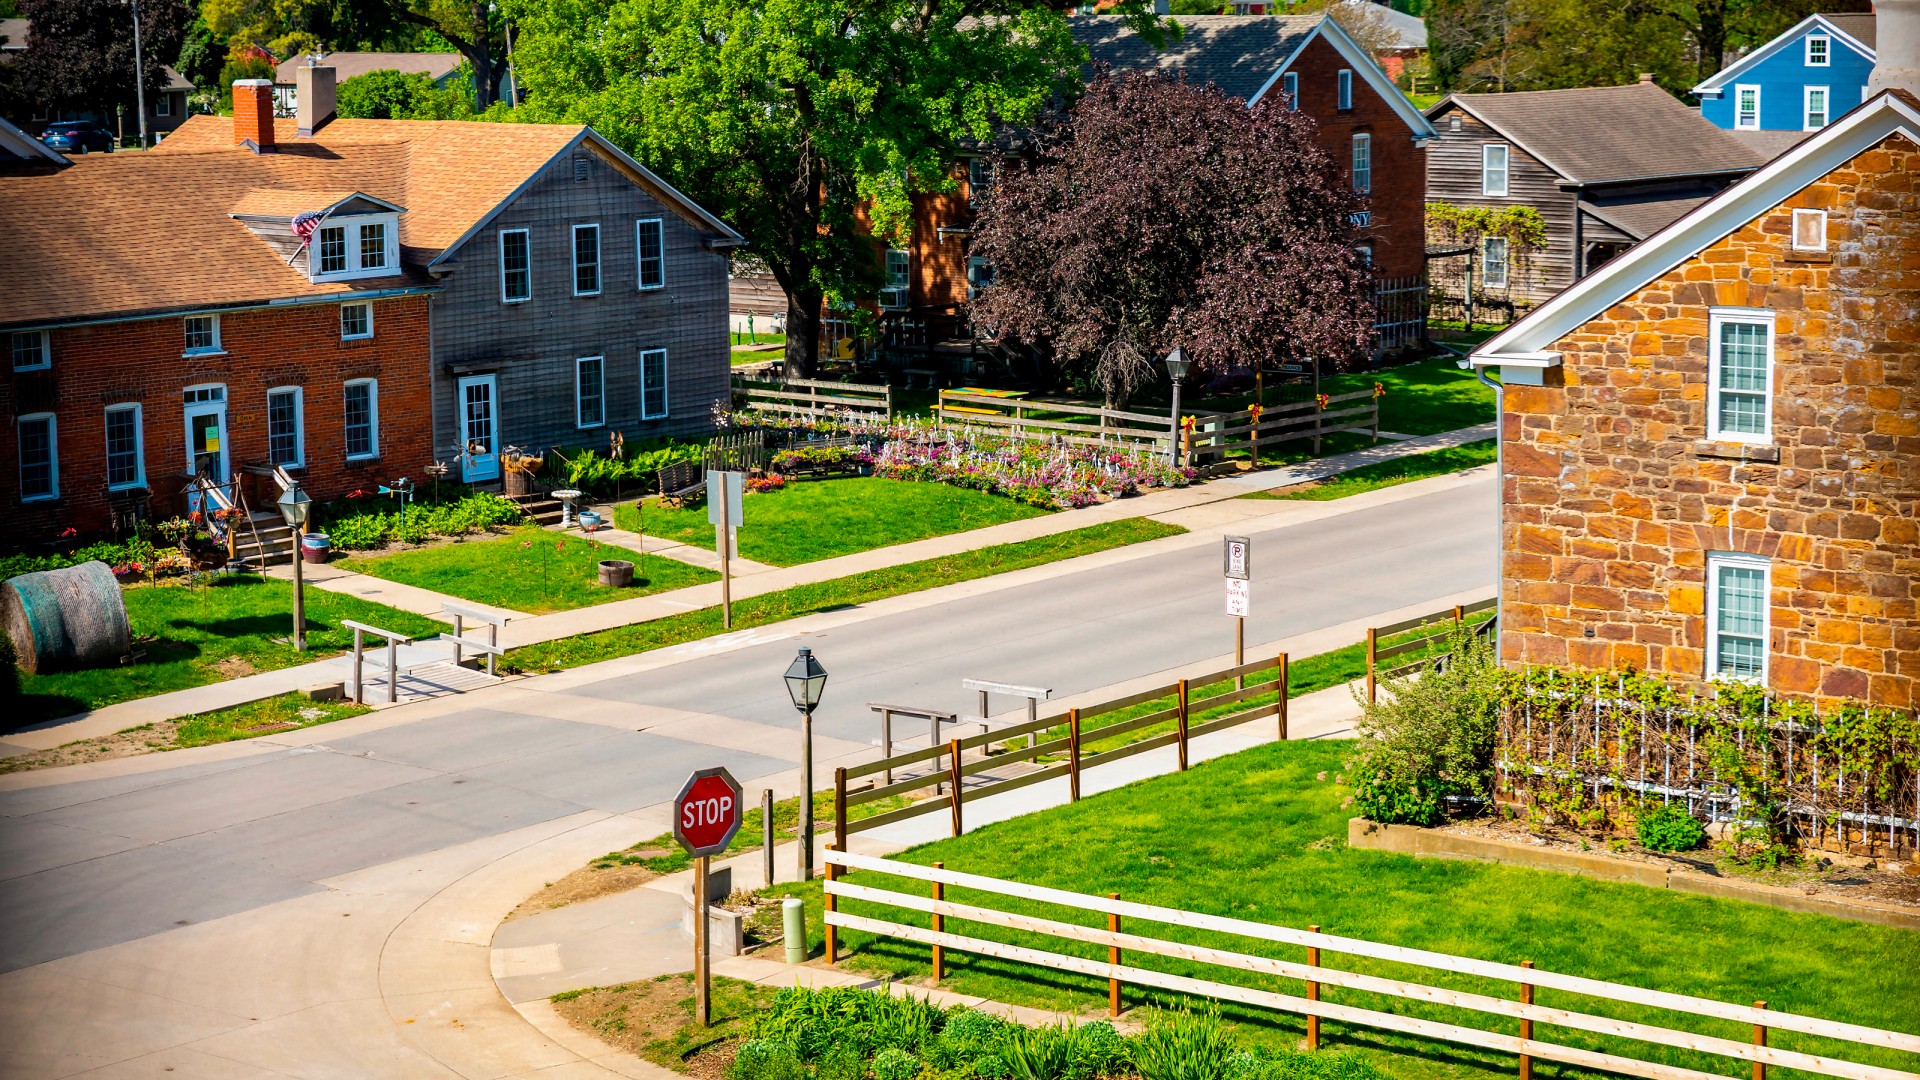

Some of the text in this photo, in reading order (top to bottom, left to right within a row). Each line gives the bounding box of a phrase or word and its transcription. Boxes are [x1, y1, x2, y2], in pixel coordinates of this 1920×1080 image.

[1232, 580, 1241, 588] NO
[1227, 589, 1248, 598] PARKING
[1231, 605, 1243, 614] TIME
[682, 796, 732, 829] STOP
